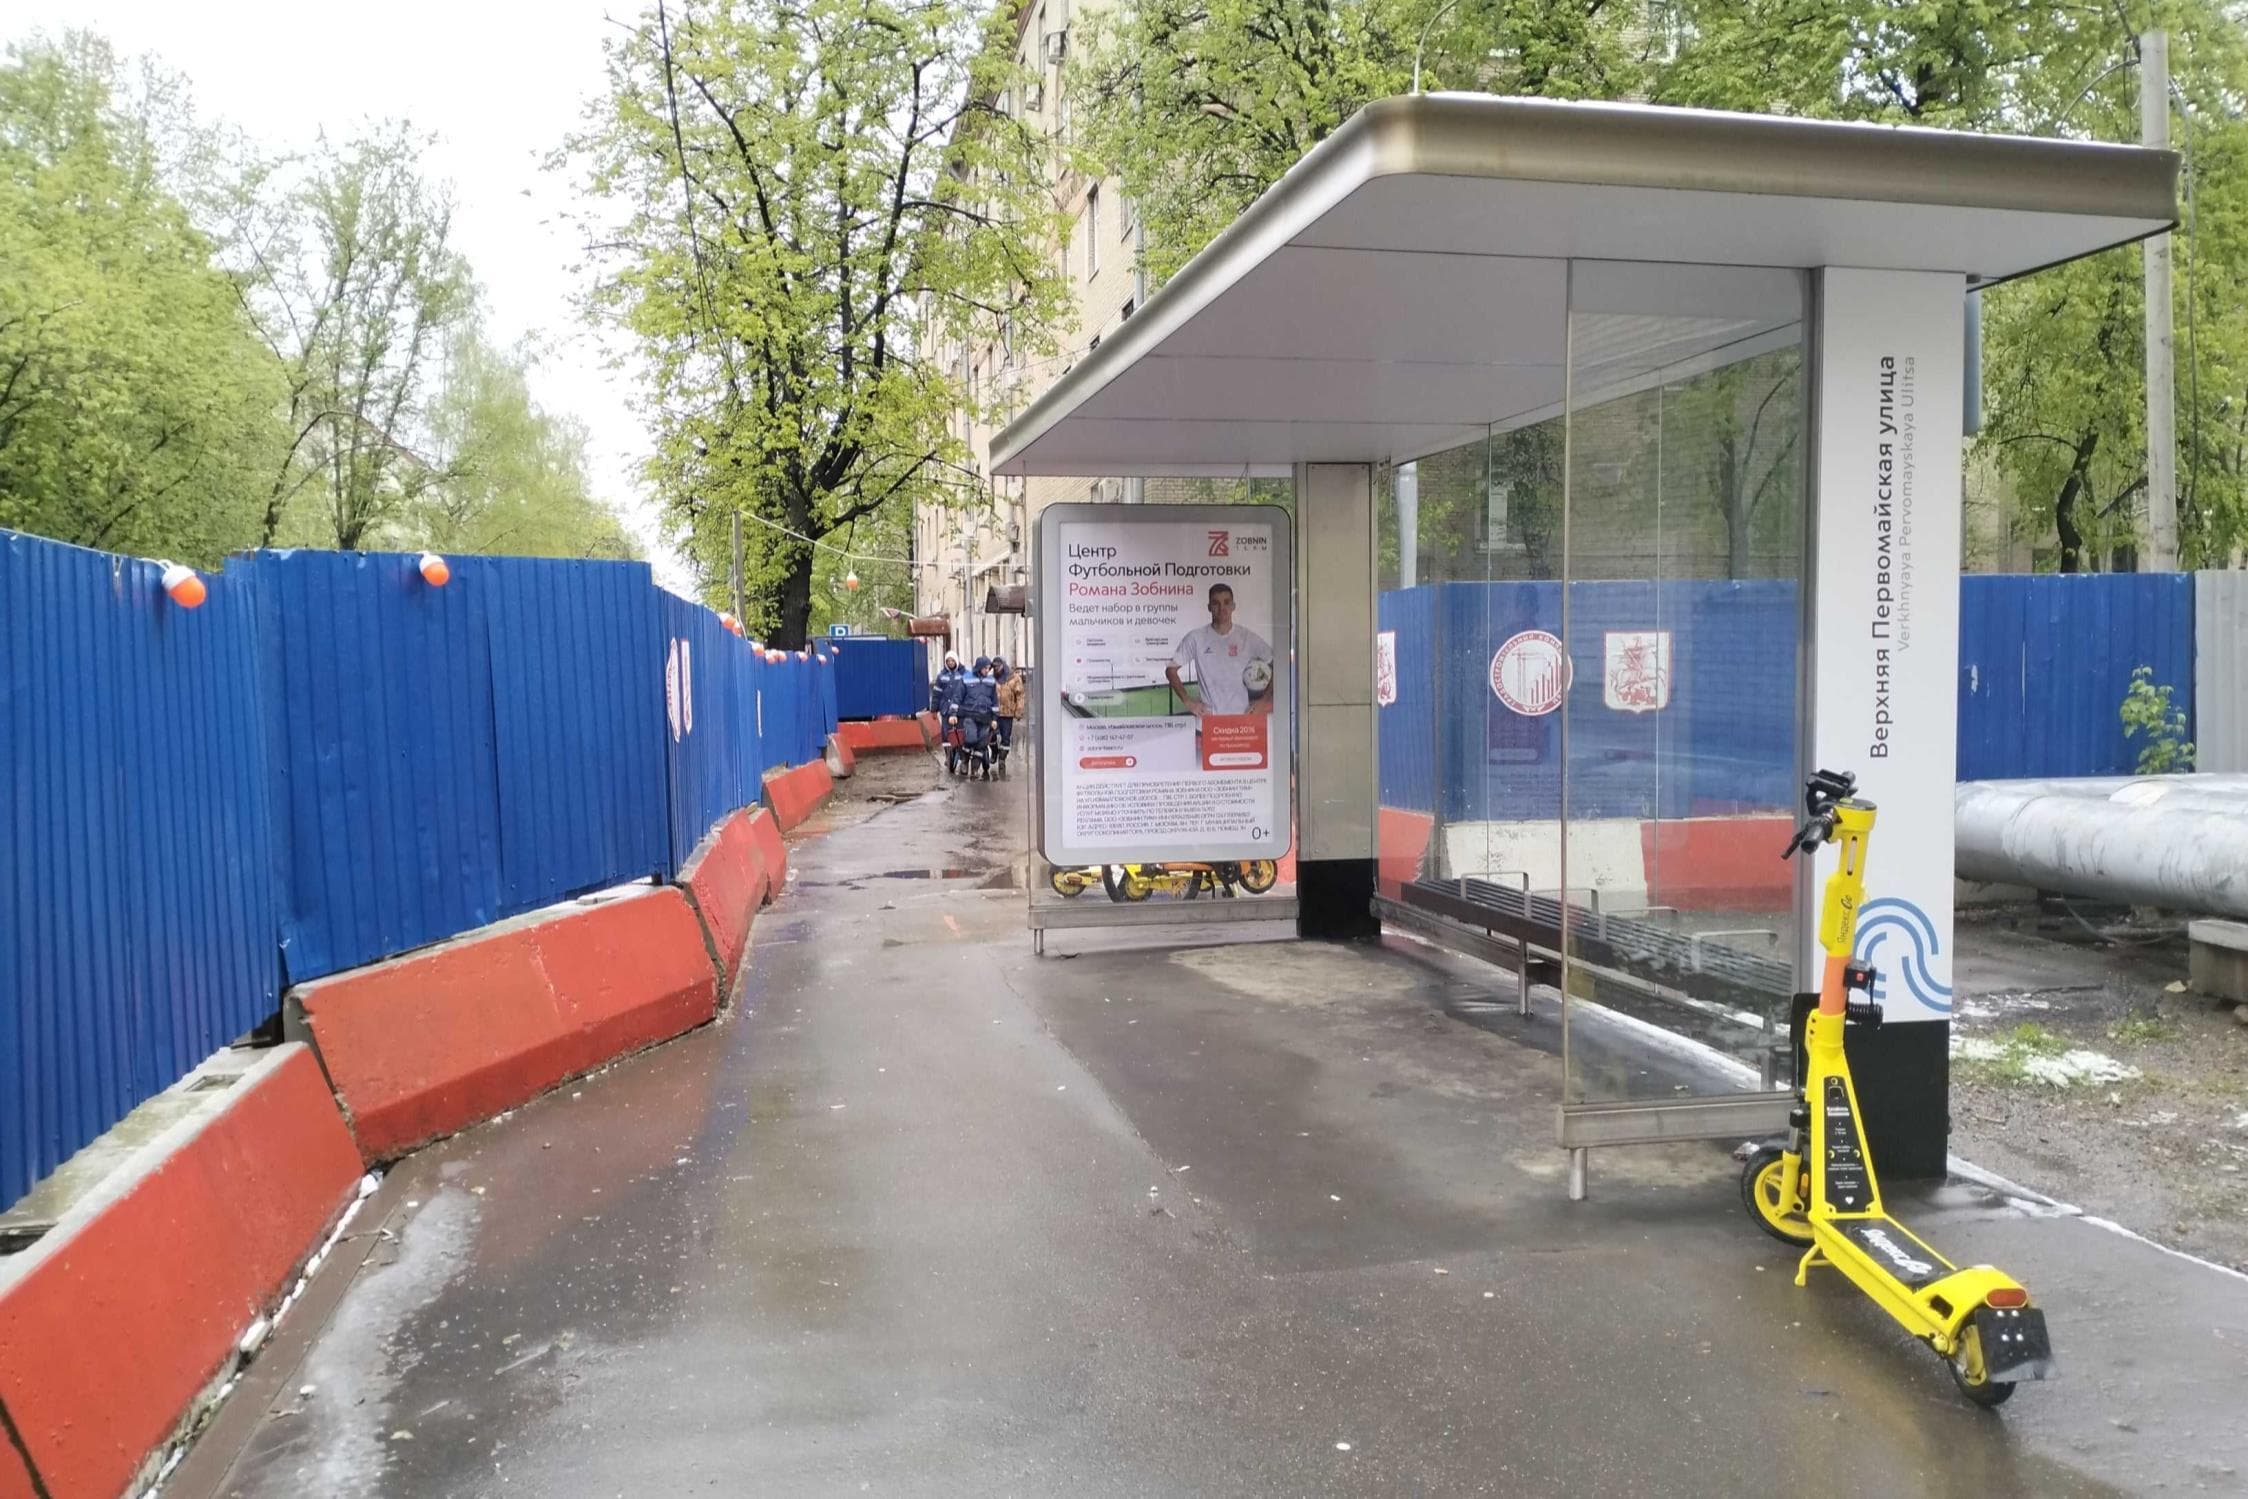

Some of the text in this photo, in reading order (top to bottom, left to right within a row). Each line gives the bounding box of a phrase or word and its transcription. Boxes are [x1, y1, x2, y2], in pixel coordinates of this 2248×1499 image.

[1898, 356, 1915, 652] Verkhnyaya Pervomayskaya Ulitsa
[1235, 536, 1267, 545] ZOBNIN
[1069, 544, 1117, 561] Центр
[1870, 355, 1897, 759] Верхняя Первомайская улица
[1069, 562, 1250, 580] Футбольной Подготовки
[1069, 581, 1194, 596] Романа Зобнина
[1069, 602, 1178, 614] Ведет набор в группы
[1069, 616, 1177, 627] мальчиков и девочек
[1251, 826, 1270, 841] 0+
